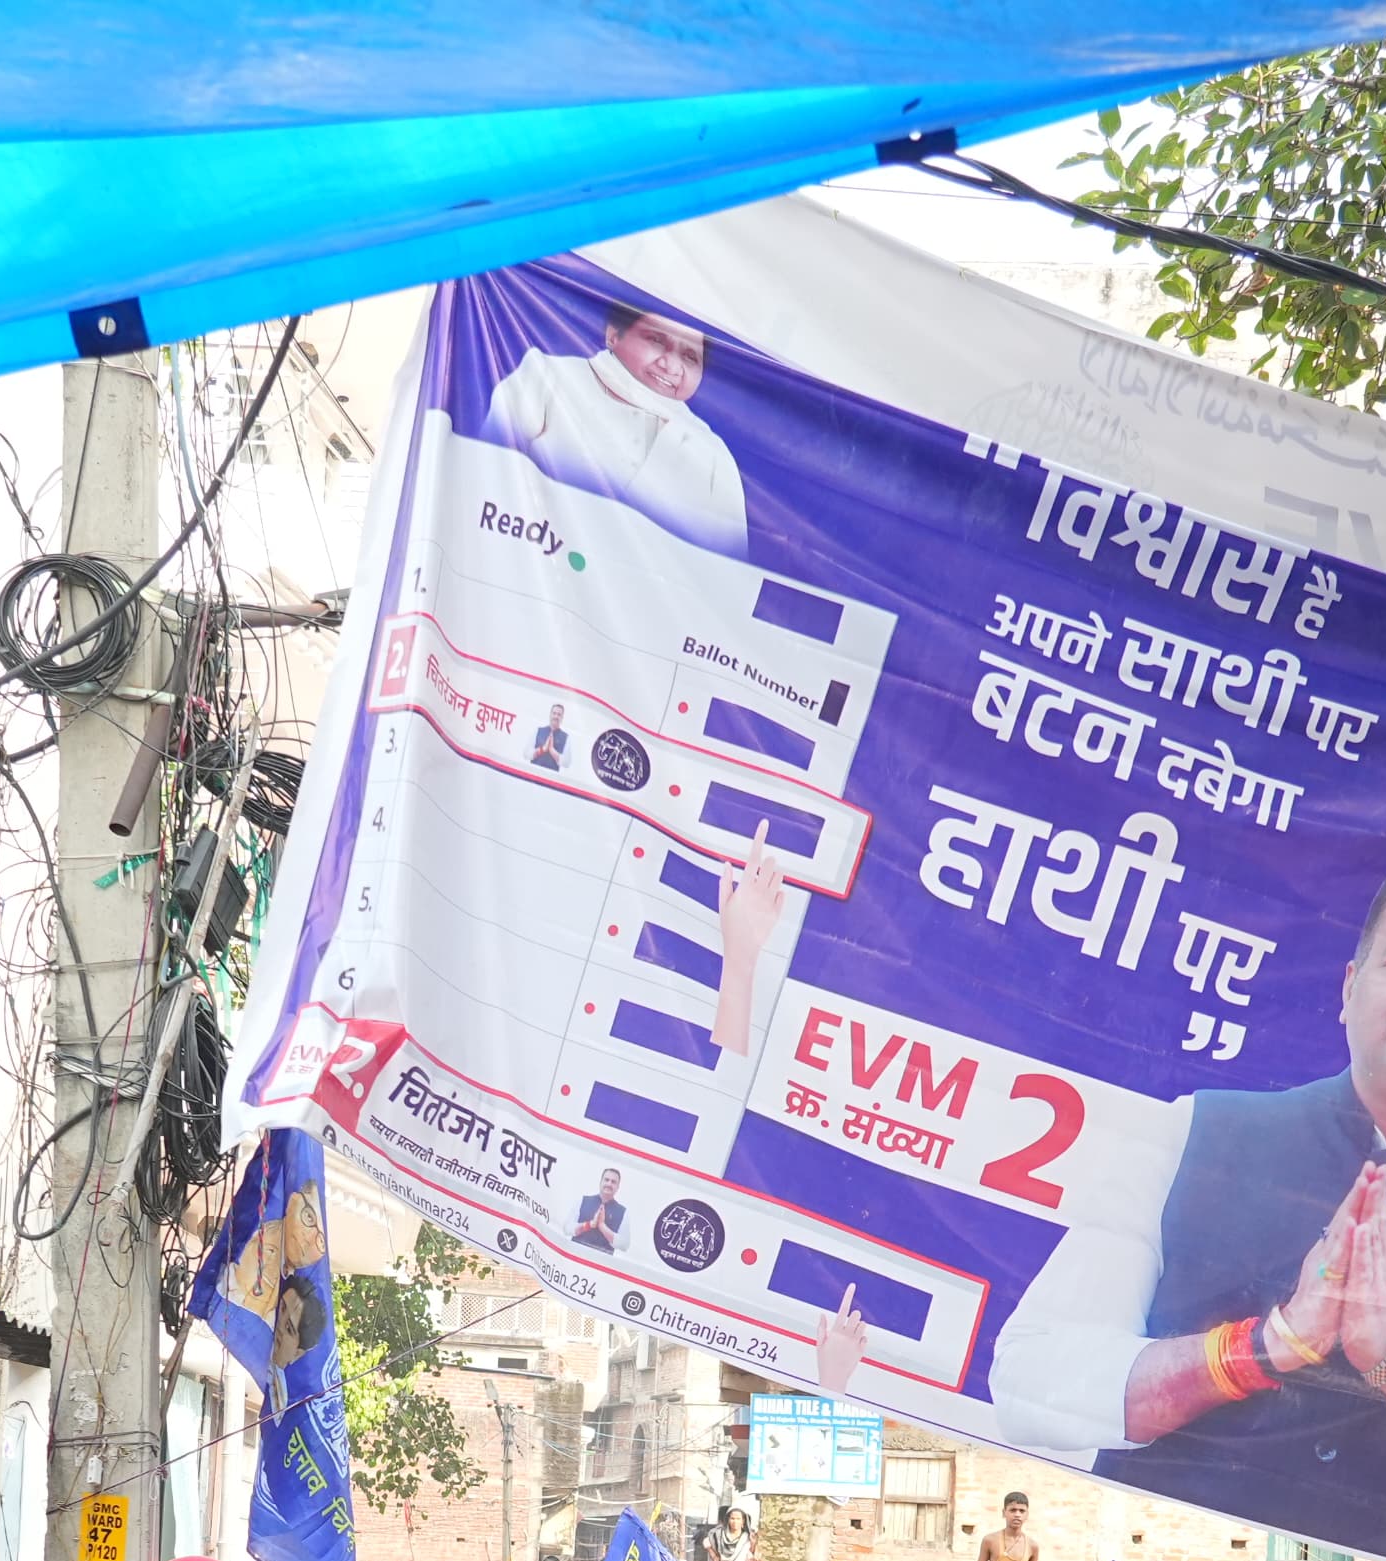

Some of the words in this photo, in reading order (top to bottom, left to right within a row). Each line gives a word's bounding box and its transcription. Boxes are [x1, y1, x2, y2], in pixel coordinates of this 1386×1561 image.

[478, 500, 564, 556] Ready
[1293, 565, 1342, 639] है
[682, 635, 740, 678] Ballot
[742, 664, 820, 714] Number
[984, 594, 1113, 674] अपने
[1118, 617, 1307, 737] साथी
[1305, 696, 1380, 763] पर
[476, 701, 517, 734] कुमार
[970, 650, 1158, 782] बटन
[1156, 737, 1306, 833] दबेगा
[918, 785, 1185, 972] हाथी
[1172, 910, 1277, 1006] पर
[388, 1065, 494, 1152] चितरंजन
[499, 1128, 557, 1188] कुमार
[785, 1081, 830, 1129] क्र.
[841, 1103, 954, 1170] संख्या
[793, 1006, 980, 1120] EVM
[979, 1073, 1086, 1210] 2
[396, 1133, 434, 1164] प्रत्याशी
[435, 1153, 483, 1189] वजीरगंज
[650, 1304, 780, 1366] Chitranjan_234
[754, 1397, 792, 1414] BIHAR
[794, 1399, 819, 1415] TILE
[821, 1402, 831, 1416] &
[284, 1426, 328, 1497] चुनाव
[87, 1513, 123, 1528] WARD
[89, 1527, 112, 1543] 47
[93, 1502, 120, 1514] GMC
